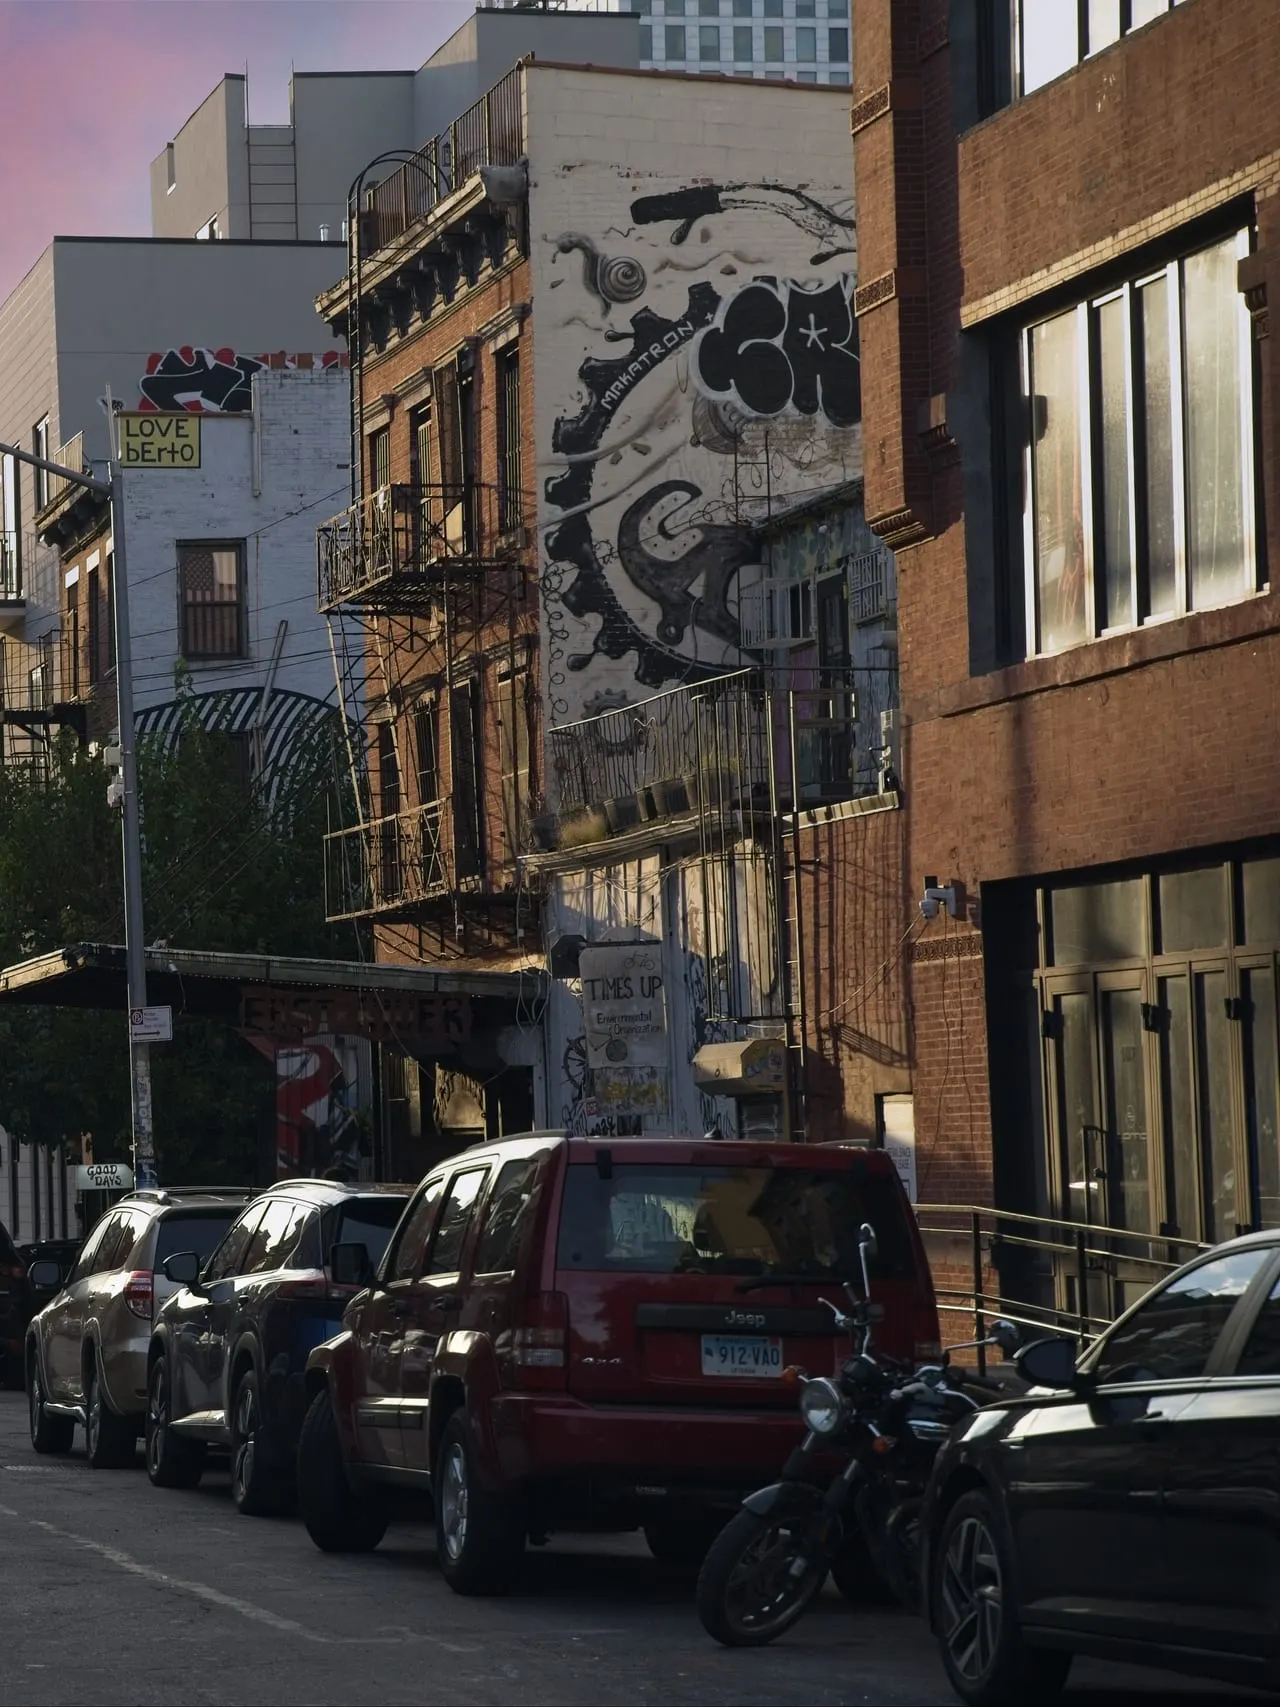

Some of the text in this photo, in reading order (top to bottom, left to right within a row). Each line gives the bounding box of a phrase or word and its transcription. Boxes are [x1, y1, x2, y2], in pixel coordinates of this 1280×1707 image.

[601, 321, 694, 410] MAKATRON
[126, 418, 189, 438] LOVE
[583, 976, 634, 1001] TIMES
[639, 975, 662, 999] UP
[86, 1164, 117, 1180] GOOD
[95, 1174, 122, 1188] DAYS
[724, 1309, 766, 1328] Jeep
